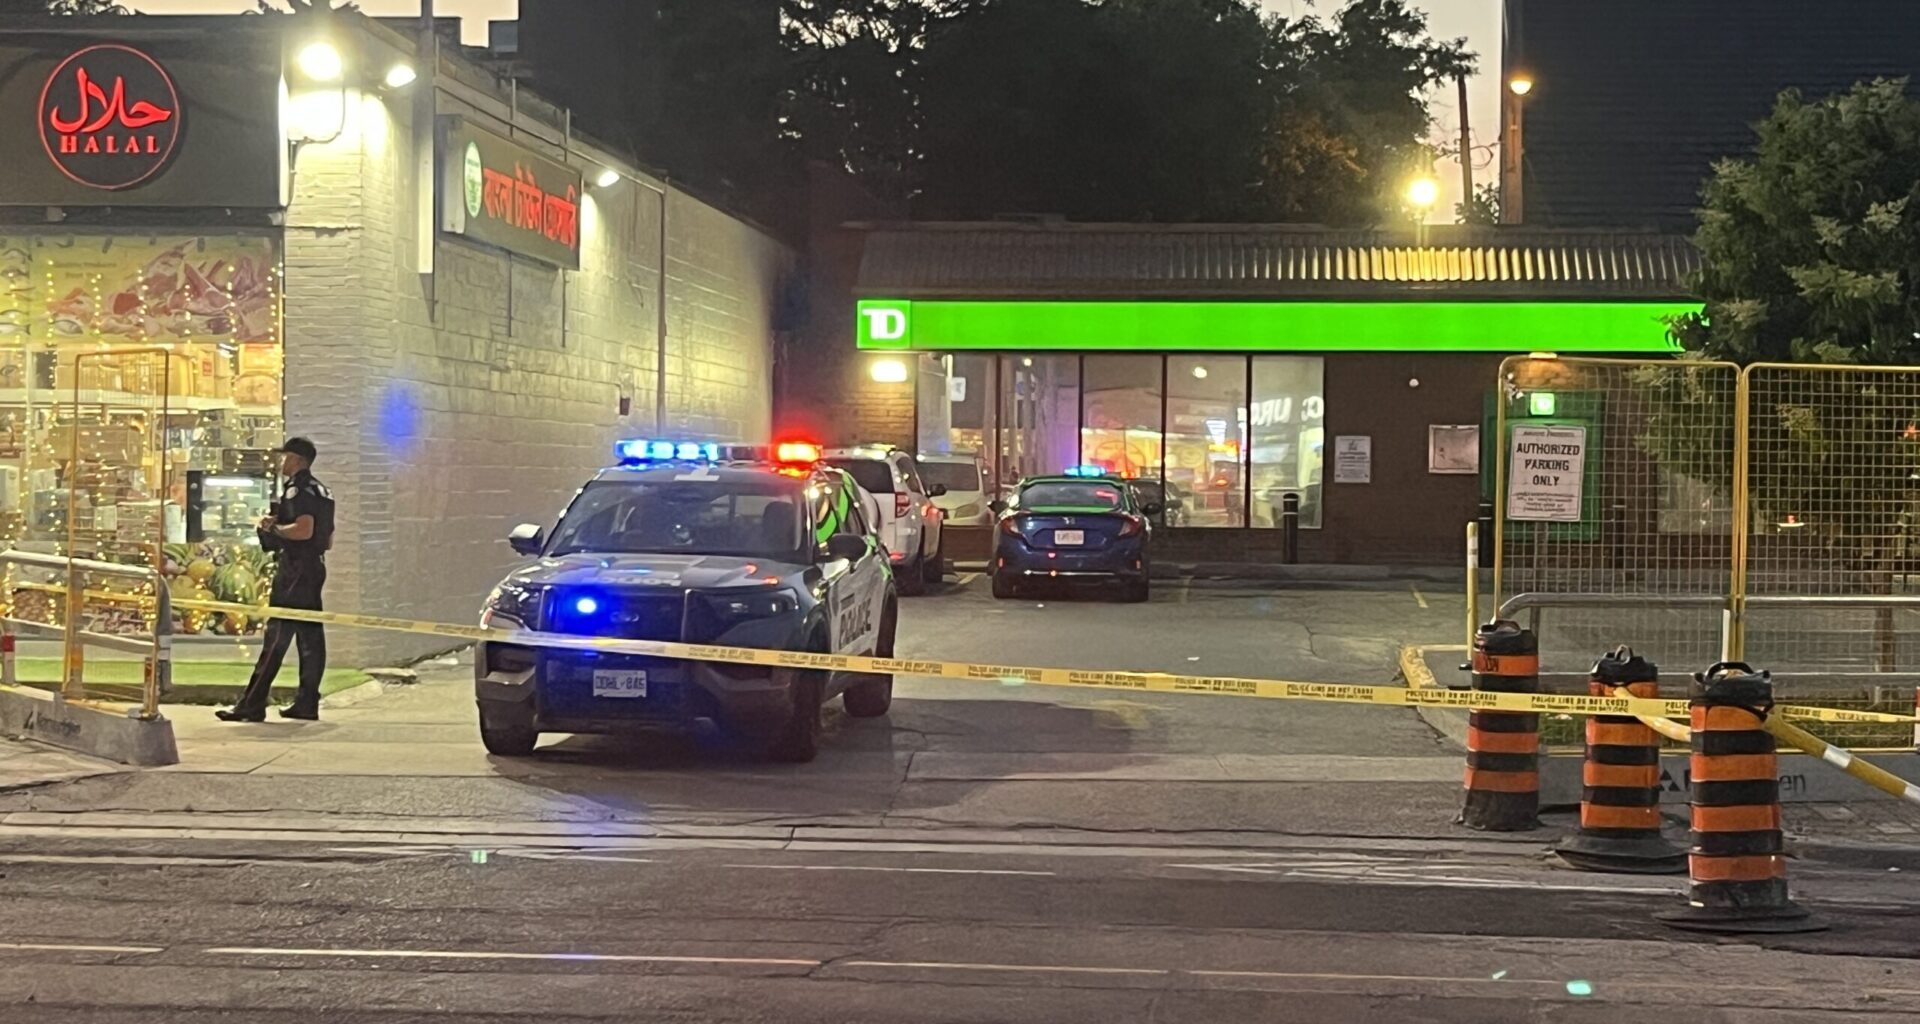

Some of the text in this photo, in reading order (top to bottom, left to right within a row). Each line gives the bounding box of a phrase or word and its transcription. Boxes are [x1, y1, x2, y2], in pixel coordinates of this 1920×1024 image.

[50, 66, 172, 133] حلال
[60, 135, 160, 153] HALAL
[862, 309, 906, 340] TD
[1516, 442, 1580, 456] AUTHORIZED
[1525, 459, 1570, 472] PARKING
[1533, 474, 1559, 487] ONLY
[1460, 692, 1473, 700] NOT
[1577, 697, 1586, 705] DO
[1665, 701, 1688, 709] POLIC
